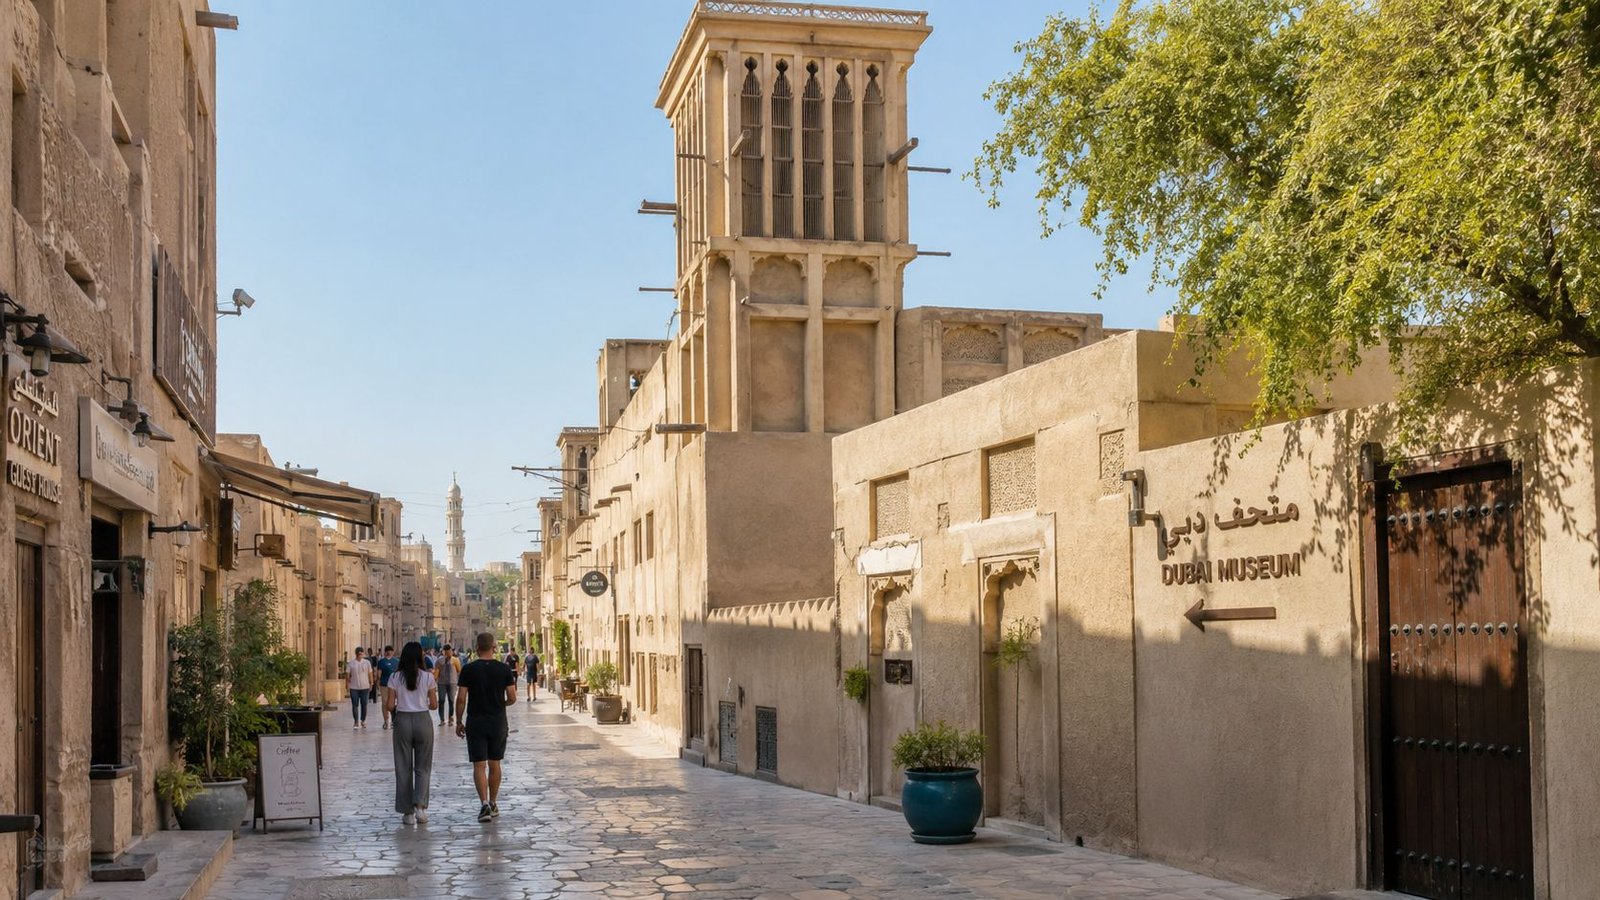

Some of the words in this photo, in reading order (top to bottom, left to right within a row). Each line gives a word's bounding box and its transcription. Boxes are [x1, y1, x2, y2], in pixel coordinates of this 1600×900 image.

[10, 406, 62, 466] ORIENT
[10, 462, 37, 492] GUEST
[1214, 494, 1300, 531] متحف
[1163, 511, 1206, 556] دبي
[1162, 560, 1213, 586] DUBAI
[1217, 552, 1301, 582] MUSEUM
